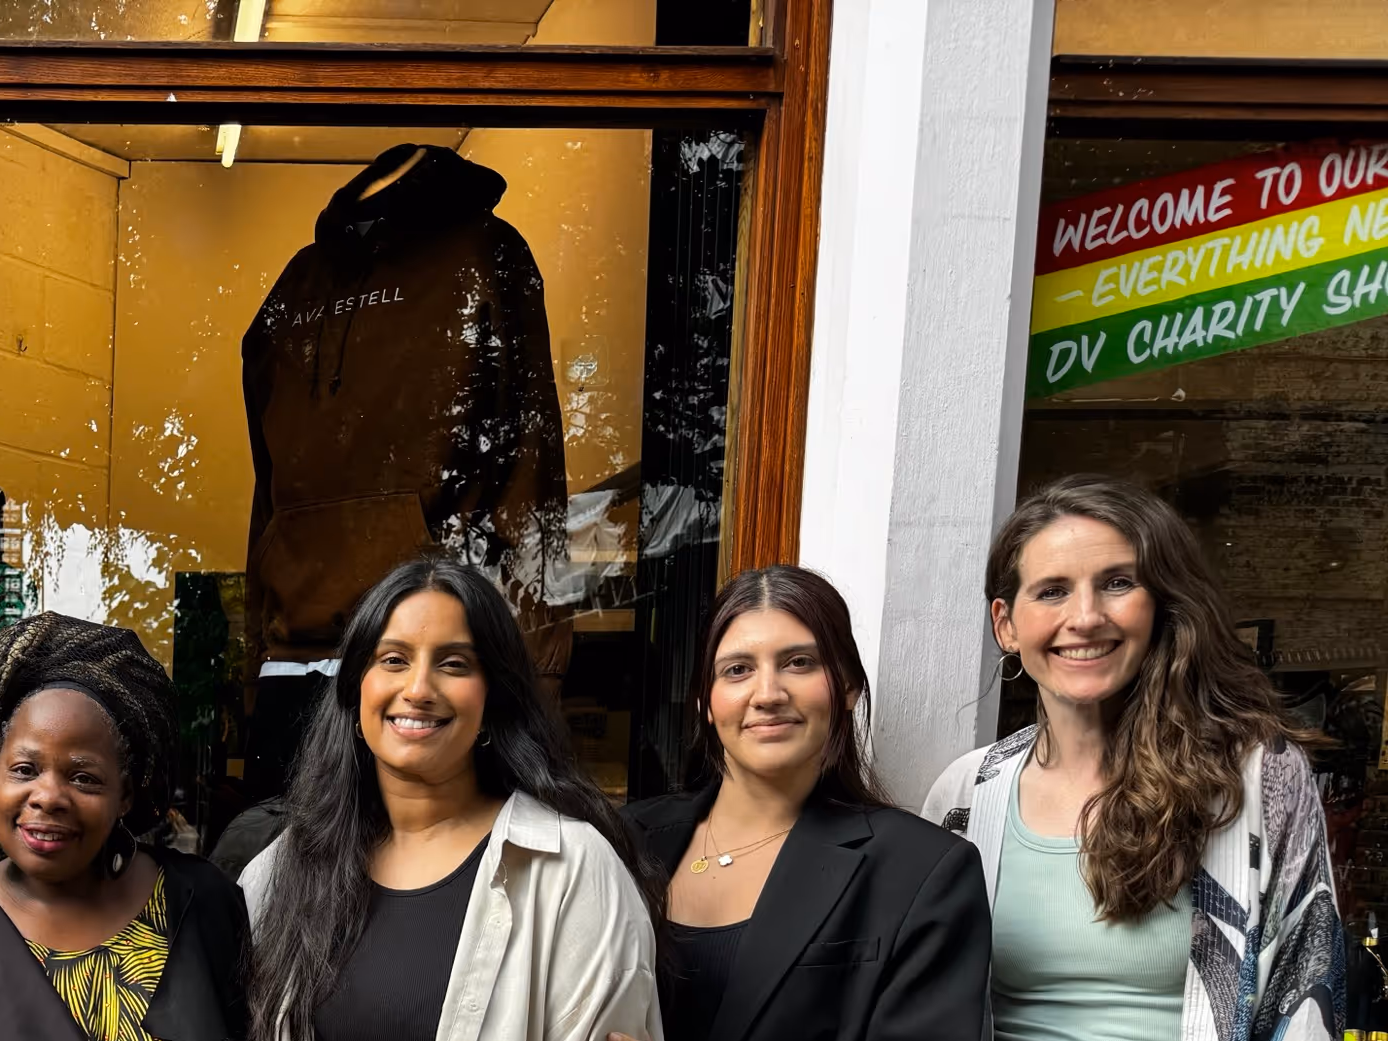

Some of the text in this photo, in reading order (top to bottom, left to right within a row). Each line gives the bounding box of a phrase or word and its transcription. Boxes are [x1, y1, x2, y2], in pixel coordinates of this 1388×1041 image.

[1052, 178, 1236, 257] WELCOME
[1255, 162, 1302, 210] TO
[334, 287, 405, 315] ESTELL
[1091, 215, 1325, 307] EVERYTHING
[1046, 260, 1388, 383] DV CHARITY SH
